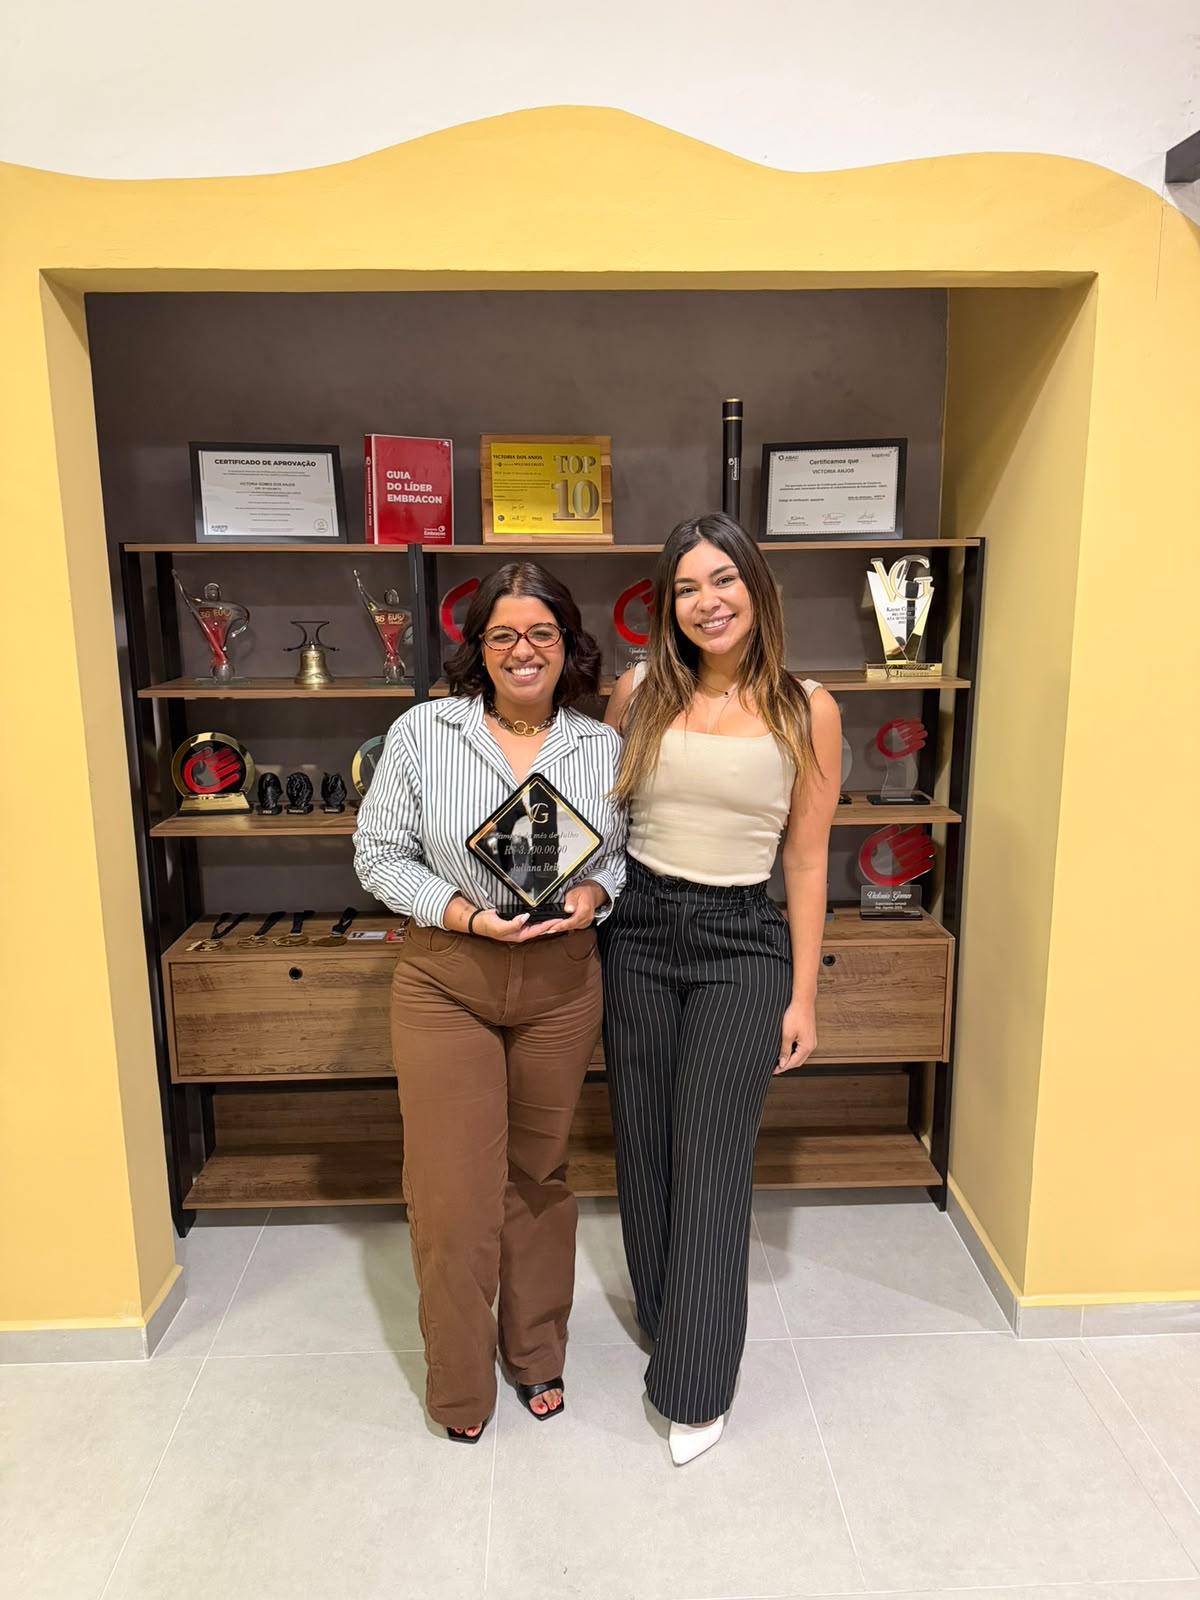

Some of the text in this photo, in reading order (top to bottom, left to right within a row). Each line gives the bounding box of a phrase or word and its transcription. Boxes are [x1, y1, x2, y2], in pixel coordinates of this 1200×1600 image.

[214, 458, 261, 466] CERTIFICADO
[273, 460, 317, 468] APROVAÇÃO
[553, 455, 597, 474] TOP
[386, 470, 411, 480] GUIA
[386, 481, 433, 492] DO LÍDER
[387, 494, 443, 504] EMBRACON
[551, 479, 600, 519] 10
[870, 554, 934, 603] VG
[511, 863, 541, 872] Juliana
